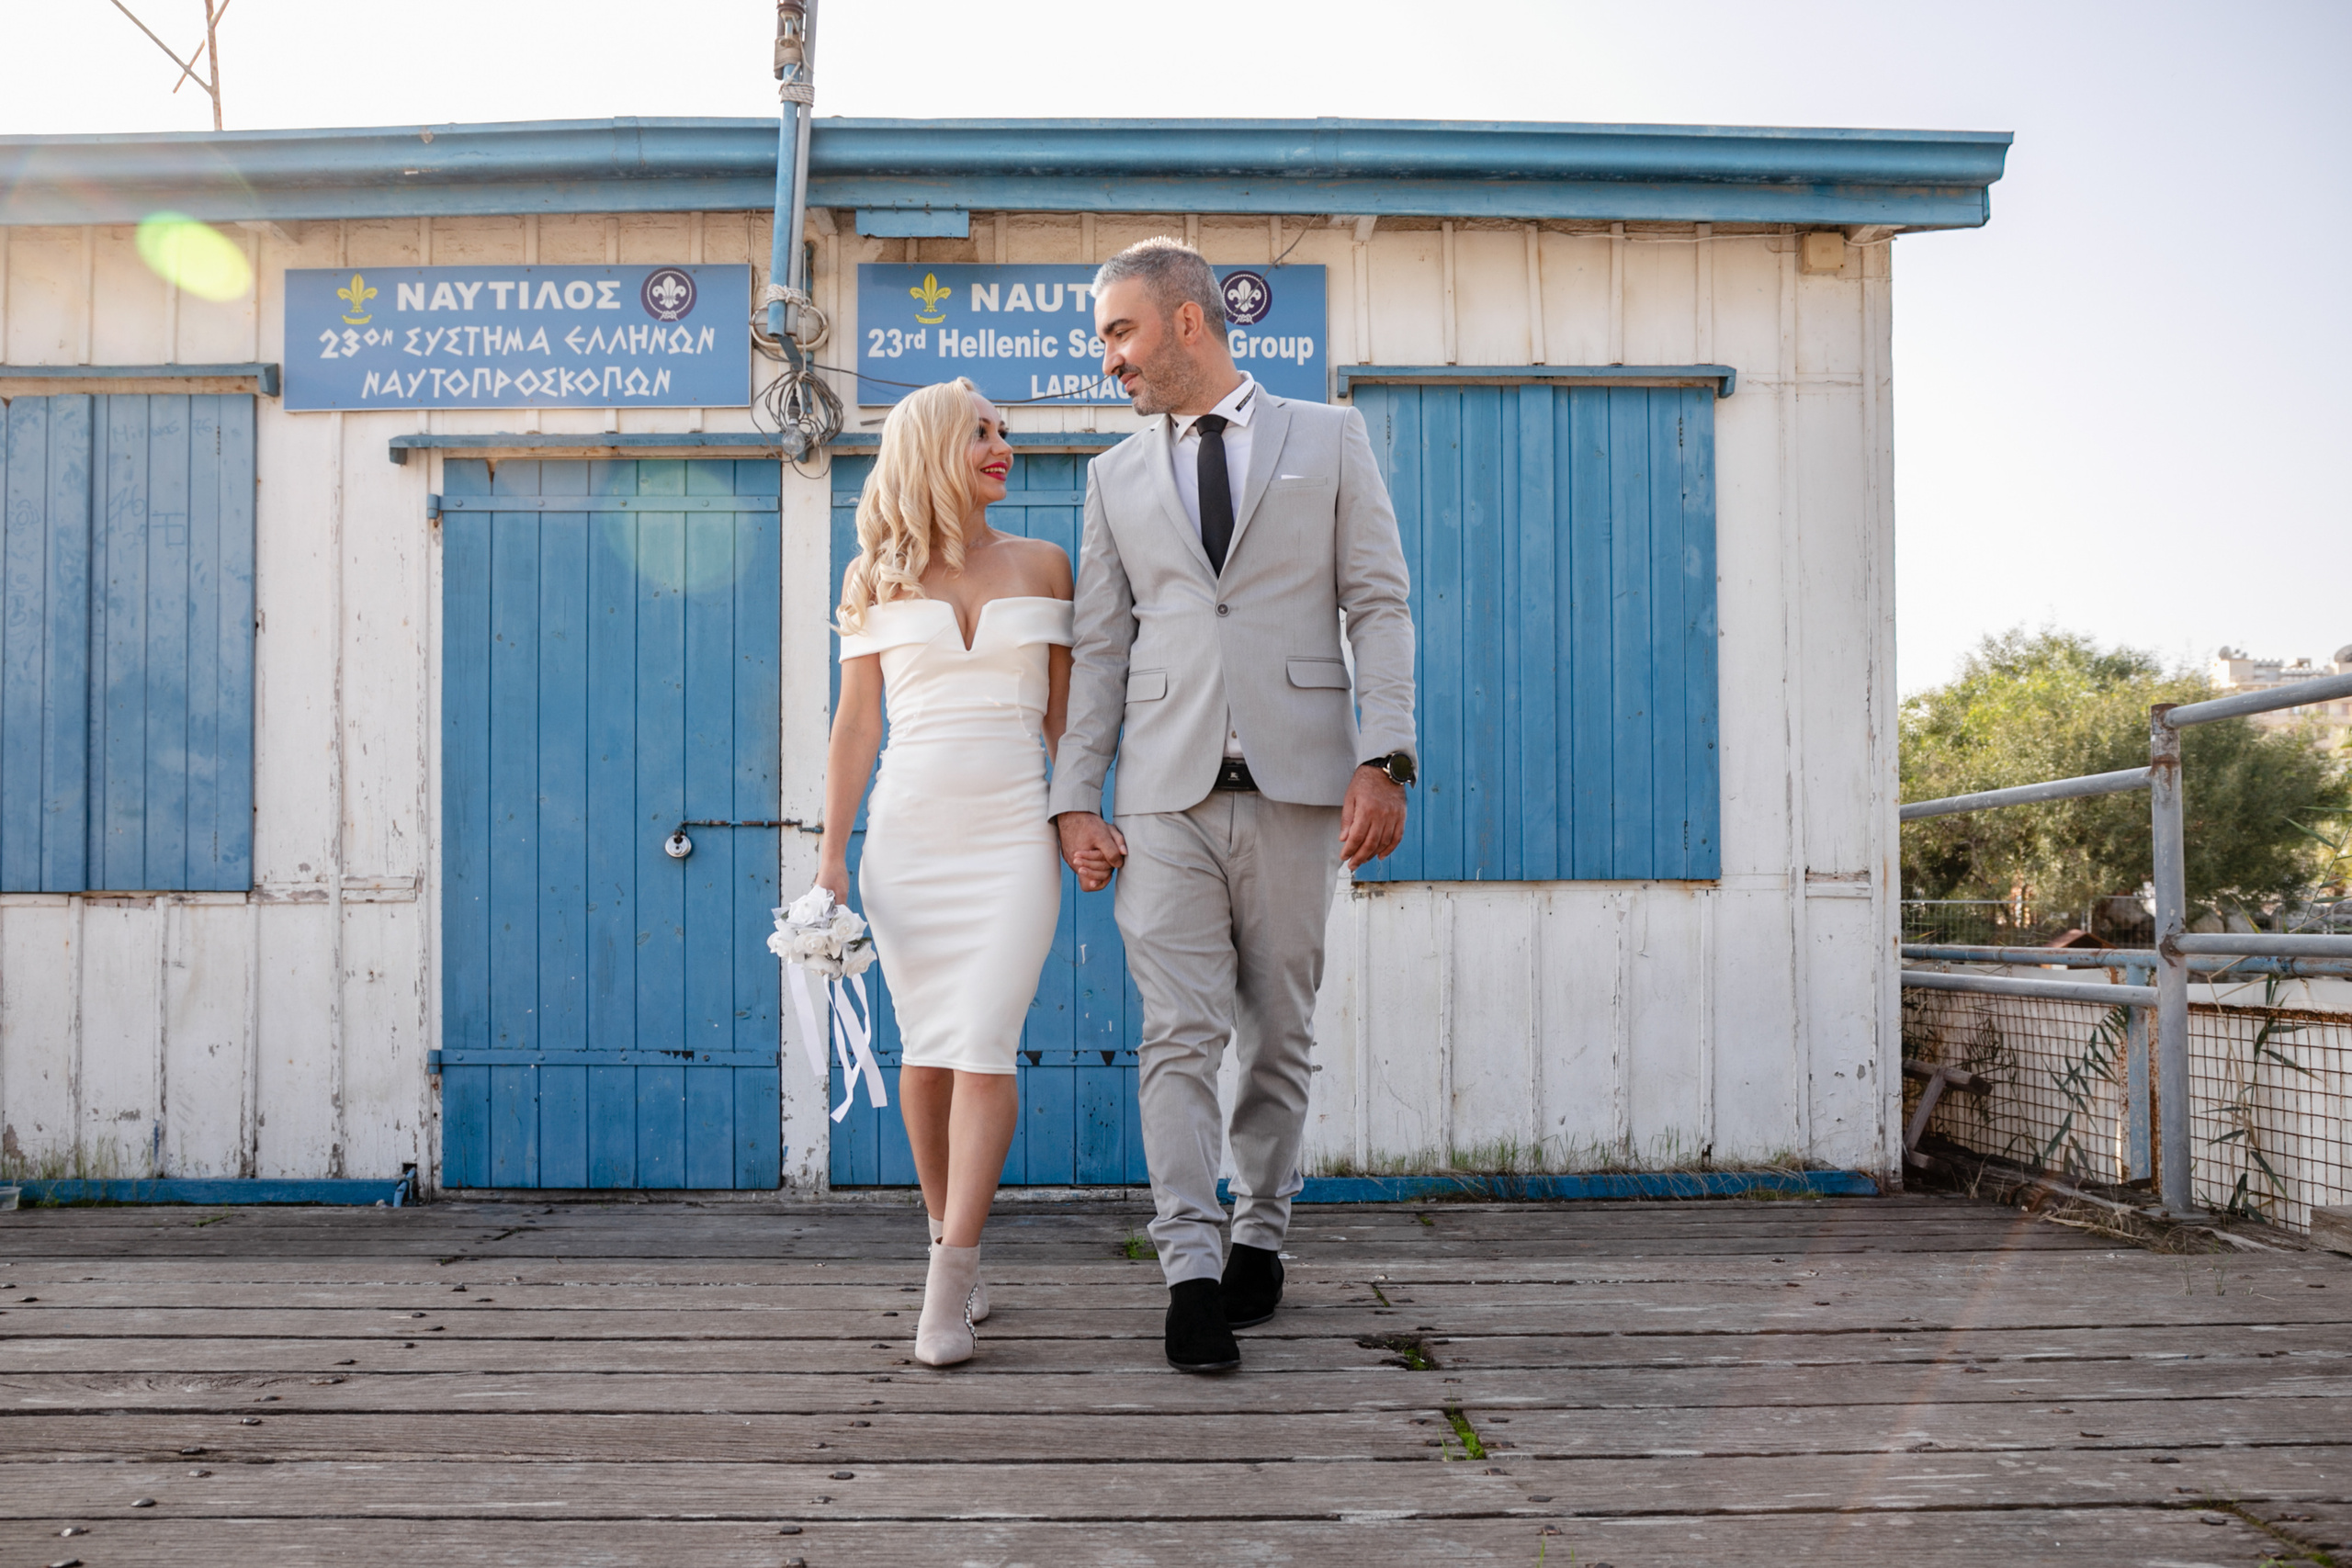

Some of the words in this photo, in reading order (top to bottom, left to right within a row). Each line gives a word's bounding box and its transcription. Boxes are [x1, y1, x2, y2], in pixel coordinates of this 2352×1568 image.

[397, 281, 621, 311] ΝΑΥΤΙΛΟΣ
[403, 325, 551, 356] ΣΥΣΤΗΜΑ
[564, 325, 715, 355] ΕΛΛΗΝΩΝ
[867, 328, 926, 358] 23rd
[939, 329, 1058, 358] Hellenic
[1227, 328, 1314, 366] Group
[361, 366, 671, 399] ΝΑΥΤΟΠΡΟΣΚΟΠΩΝ
